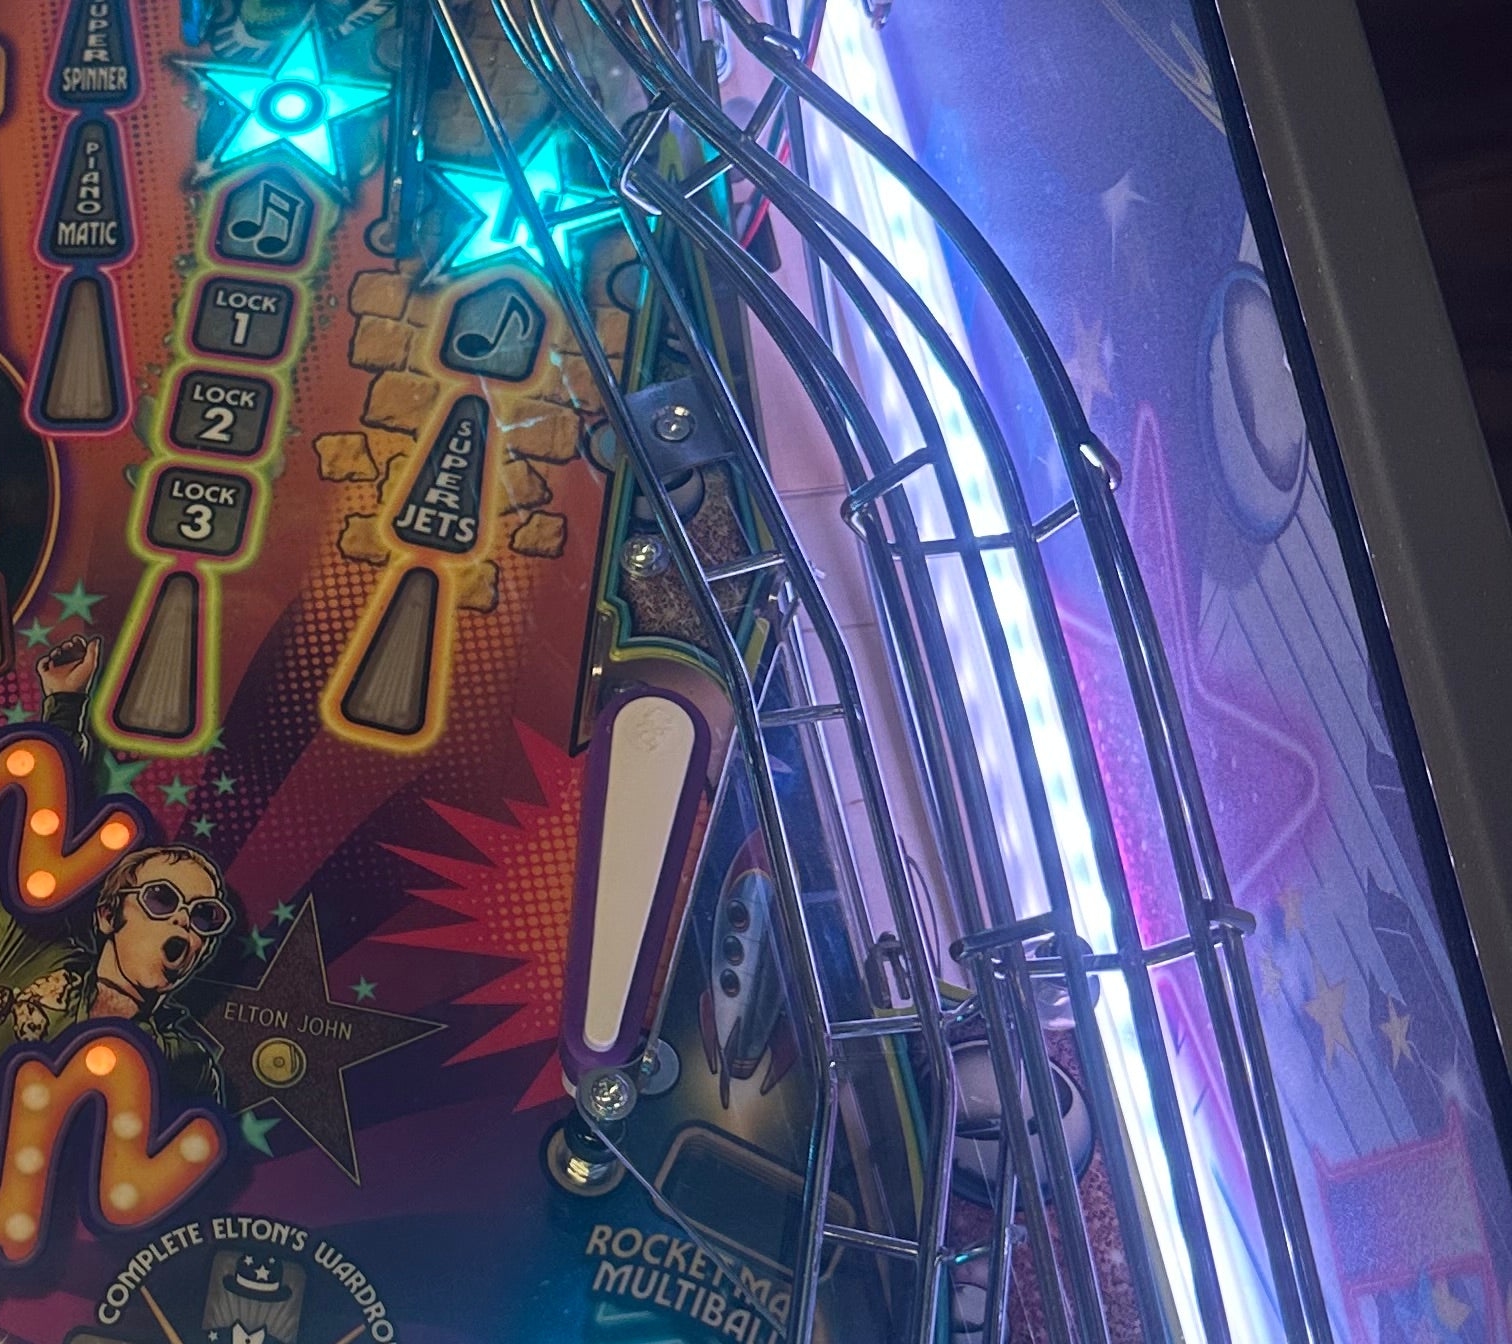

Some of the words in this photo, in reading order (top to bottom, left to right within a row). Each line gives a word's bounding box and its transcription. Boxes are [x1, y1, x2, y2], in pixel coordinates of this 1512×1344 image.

[62, 64, 129, 93] SPINNER
[57, 218, 119, 248] MATIC
[215, 288, 278, 314] LOCK
[231, 313, 248, 346] 1
[192, 383, 256, 410] LOCK
[198, 407, 232, 444] 2
[425, 419, 473, 509] SUPER
[171, 478, 238, 506] LOCK
[179, 501, 214, 542] 3
[396, 502, 476, 545] JETS
[224, 1000, 289, 1030] ELTON
[296, 1008, 355, 1043] JOHN
[97, 1221, 205, 1326] COMPLETE
[211, 1216, 308, 1252] ELTON'S
[586, 1223, 734, 1288] ROCKET
